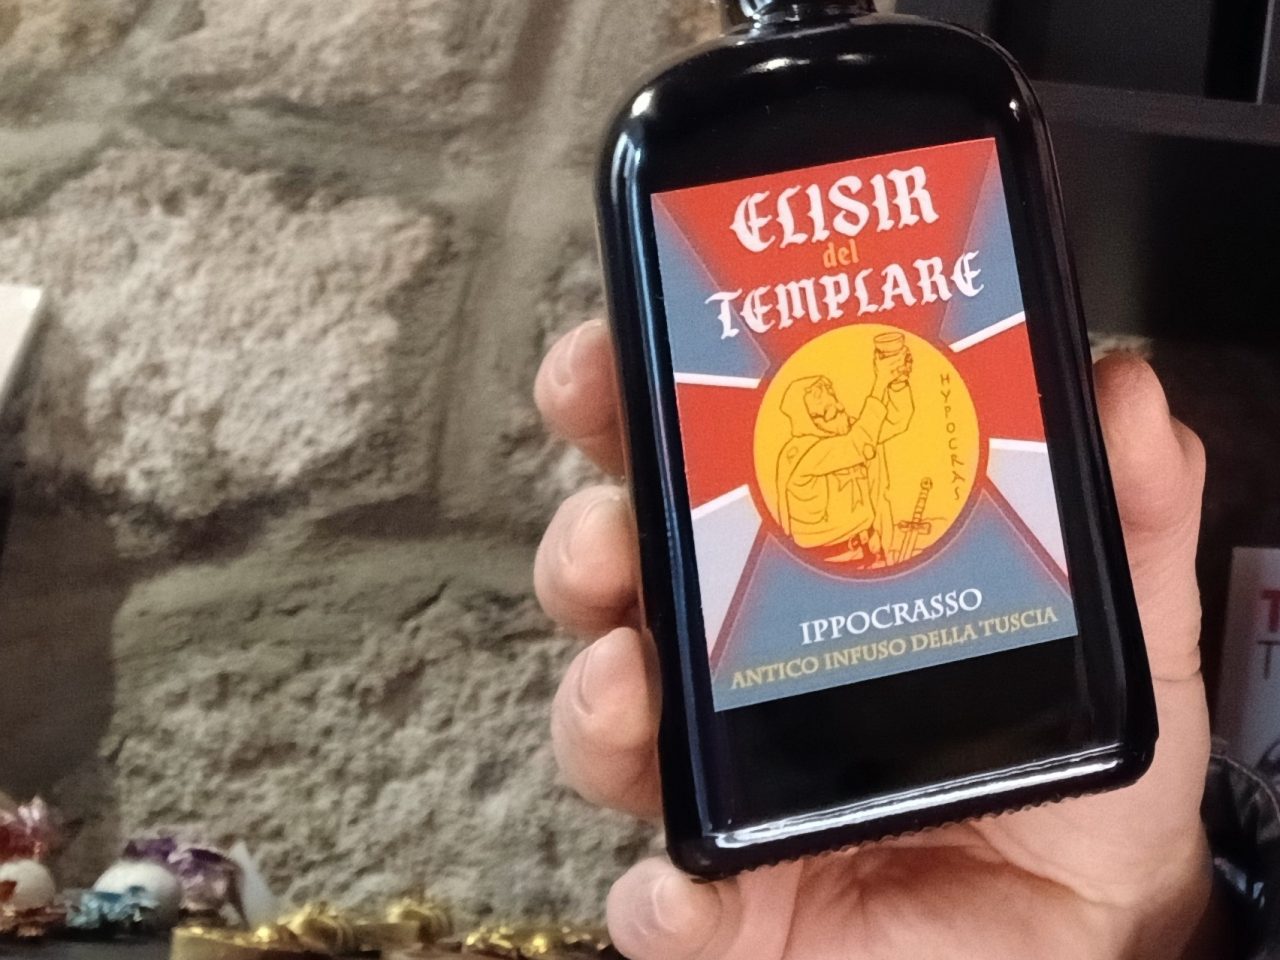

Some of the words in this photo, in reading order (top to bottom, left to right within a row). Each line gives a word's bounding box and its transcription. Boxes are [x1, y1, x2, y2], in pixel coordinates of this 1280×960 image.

[729, 166, 940, 252] ELISIR
[704, 250, 985, 340] TEMPLARE
[822, 238, 860, 269] del
[730, 656, 819, 690] ANTICO
[824, 639, 907, 671] INFUSO
[911, 625, 978, 653] DELLA
[978, 606, 1059, 637] TUSCIA
[800, 588, 983, 645] IPPOCRASSO
